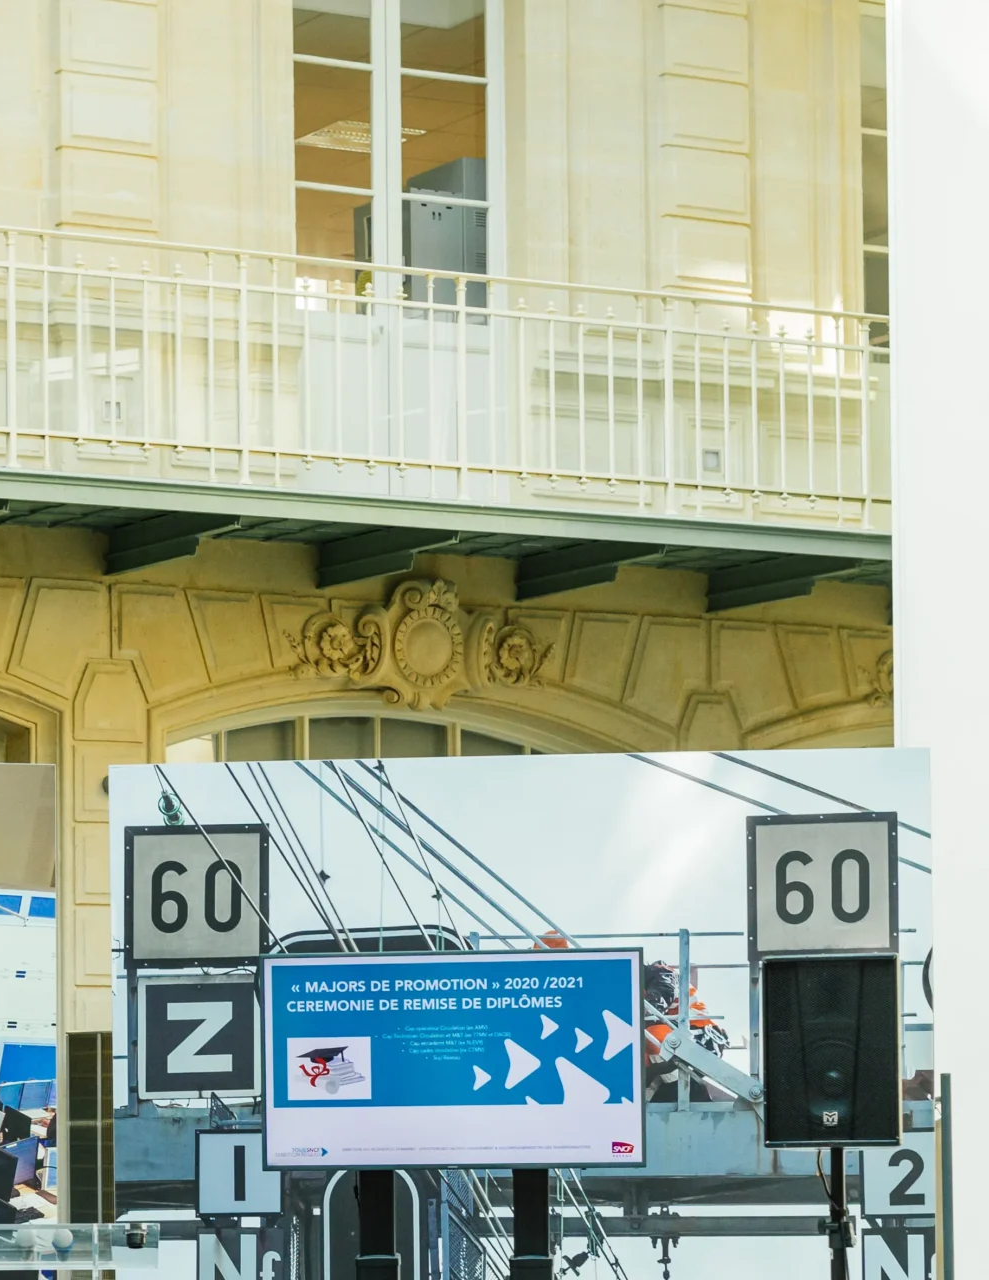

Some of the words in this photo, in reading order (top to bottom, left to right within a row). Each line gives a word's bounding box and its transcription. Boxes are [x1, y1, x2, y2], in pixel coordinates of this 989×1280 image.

[151, 859, 242, 933] 60
[775, 849, 870, 925] 60
[286, 999, 374, 1012] CEREMONIE
[379, 999, 399, 1011] DE
[403, 998, 457, 1010] REMISE
[461, 997, 481, 1009] DE
[486, 994, 562, 1009] DIPLÔMES
[305, 981, 366, 993] MAJORS
[370, 980, 390, 992] DE
[395, 979, 487, 992] PROMOTION
[504, 977, 539, 990] 2020
[543, 976, 583, 990] /2021
[167, 1001, 233, 1074] Z
[888, 1149, 925, 1206] 2
